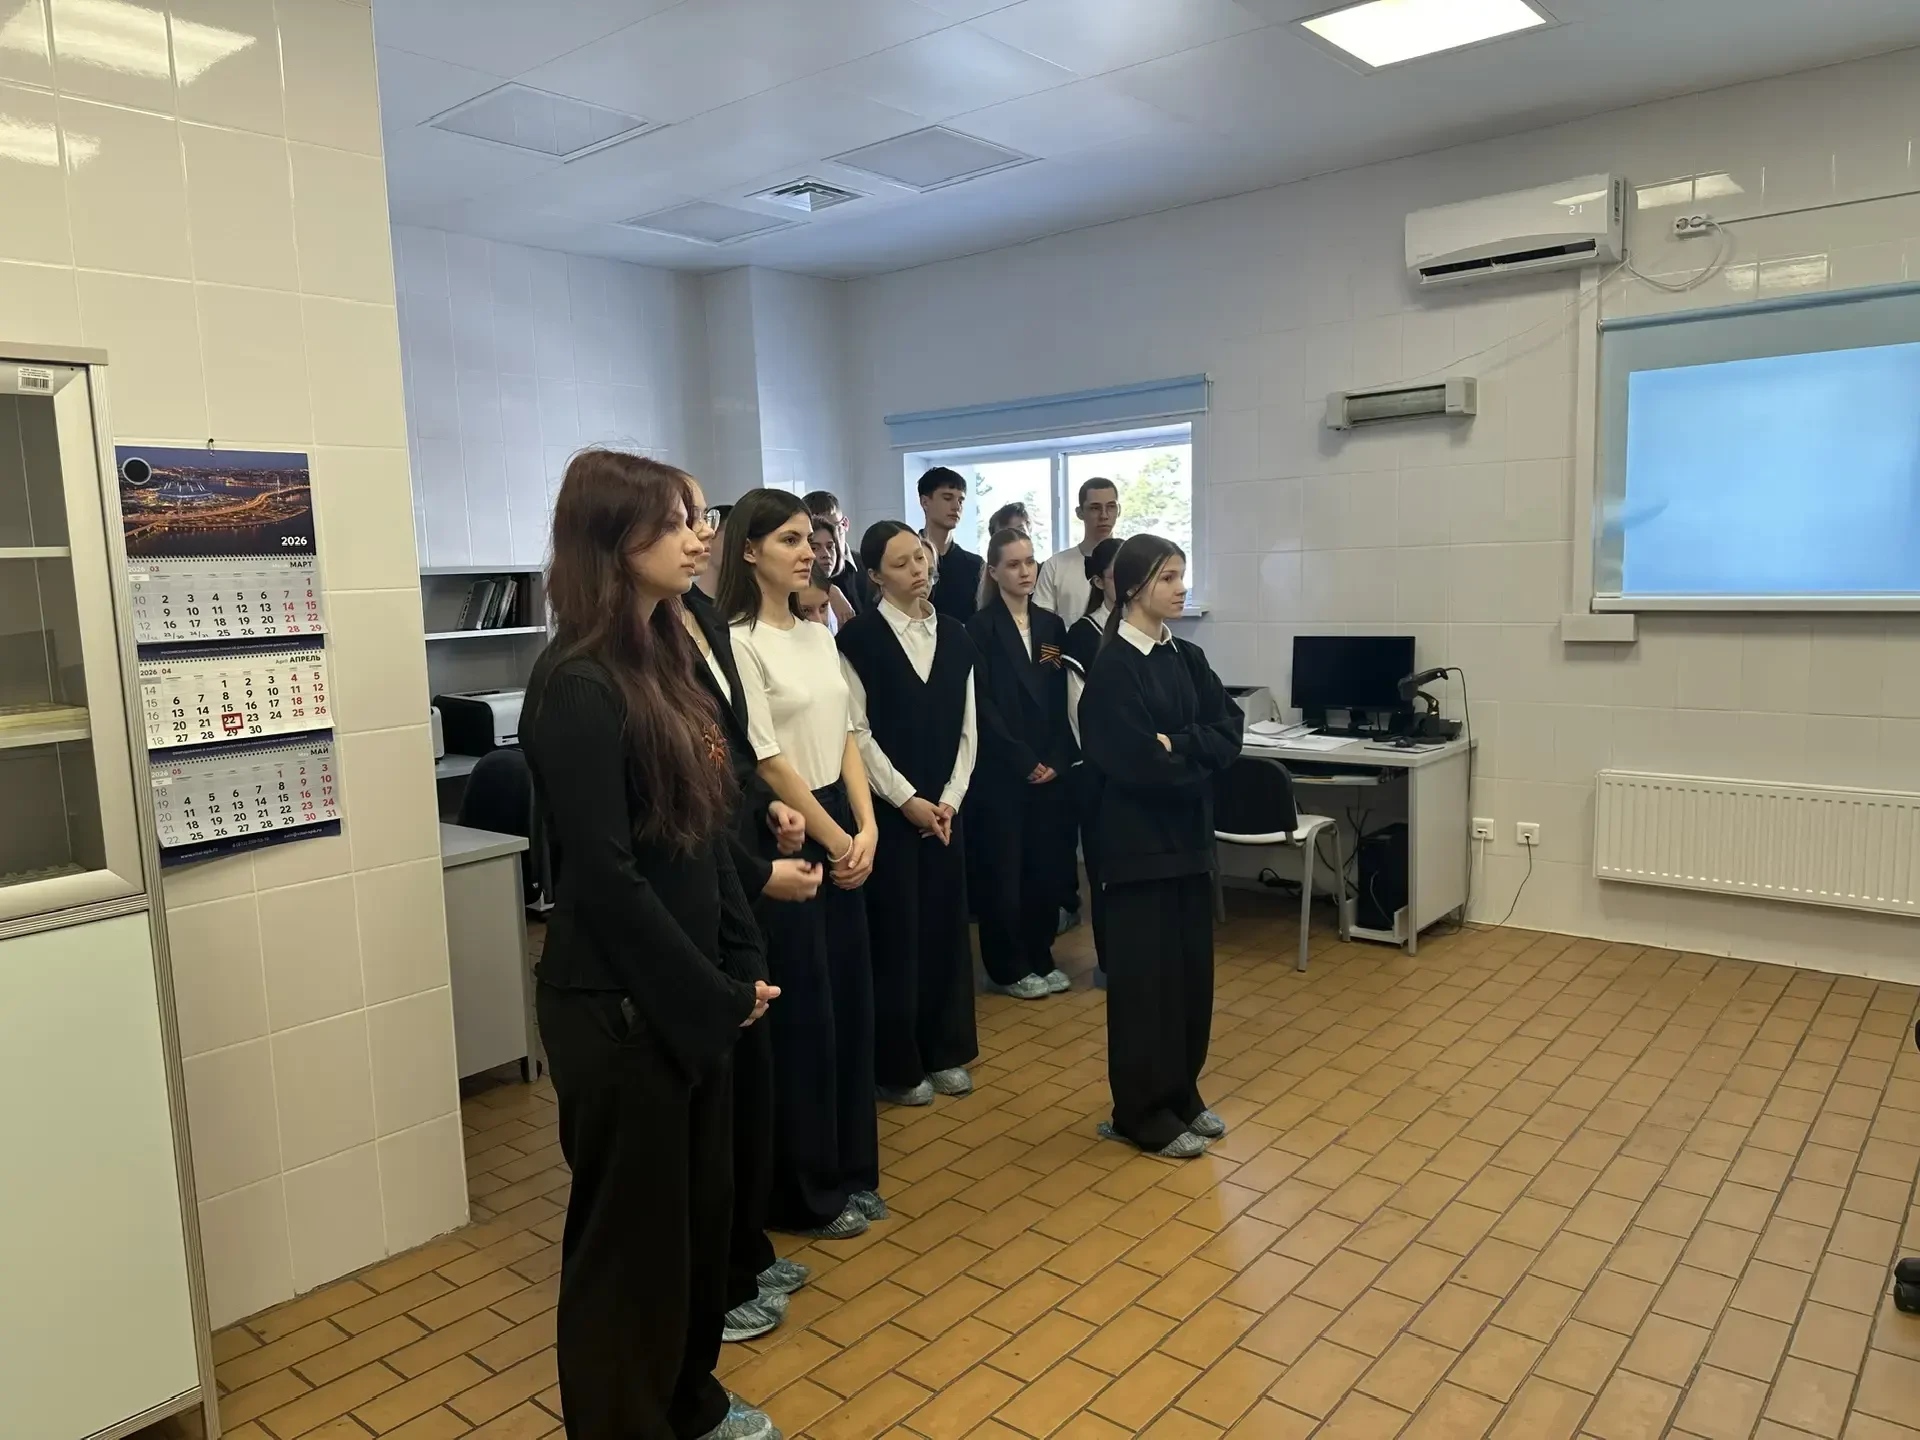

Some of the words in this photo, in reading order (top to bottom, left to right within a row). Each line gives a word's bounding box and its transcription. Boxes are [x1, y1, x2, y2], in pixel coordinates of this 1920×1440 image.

[1568, 204, 1583, 216] 21
[281, 536, 308, 546] 2026
[133, 596, 146, 605] 10
[162, 595, 169, 604] 2
[187, 594, 194, 603] 3
[212, 593, 219, 601] 4
[237, 592, 244, 600] 5
[260, 591, 267, 600] 6
[284, 590, 290, 598] 7
[306, 589, 313, 598] 8
[134, 583, 141, 592] 9
[136, 610, 147, 618] 11
[163, 608, 170, 617] 9
[186, 607, 199, 616] 10
[212, 606, 223, 614] 11
[236, 604, 248, 613] 12
[260, 603, 271, 612] 13
[282, 602, 294, 611] 14
[306, 601, 317, 610] 15
[138, 622, 151, 630] 12
[163, 621, 177, 629] 16
[189, 619, 200, 628] 17
[214, 618, 226, 626] 18
[238, 616, 250, 625] 19
[261, 616, 274, 624] 20
[284, 614, 296, 622] 21
[307, 613, 318, 621] 22
[290, 655, 321, 663] АПРЕЛЬ
[144, 686, 156, 695] 14
[222, 680, 227, 688] 1
[245, 678, 251, 686] 2
[268, 676, 275, 684] 3
[314, 672, 320, 680] 5
[146, 698, 158, 708] 15
[173, 696, 180, 705] 6
[198, 694, 204, 703] 7
[222, 692, 229, 700] 8
[246, 690, 253, 698] 9
[267, 687, 278, 696] 10
[290, 685, 300, 694] 11
[313, 683, 324, 691] 12
[147, 712, 159, 720] 16
[172, 708, 184, 718] 13
[196, 706, 209, 715] 14
[222, 704, 233, 712] 15
[245, 701, 257, 710] 16
[269, 699, 279, 708] 17
[291, 697, 302, 705] 18
[314, 694, 325, 703] 19
[148, 724, 160, 734] 17
[173, 721, 186, 731] 20
[198, 718, 210, 728] 21
[223, 716, 236, 725] 22
[246, 713, 259, 722] 23
[269, 711, 282, 719] 24
[292, 708, 304, 717] 25
[314, 706, 326, 714] 26
[152, 736, 164, 745] 18
[175, 734, 188, 742] 27
[200, 731, 214, 740] 28
[226, 728, 239, 737] 29
[249, 725, 262, 734] 30
[156, 787, 168, 797] 18
[300, 767, 306, 775] 2
[322, 764, 328, 772] 3
[157, 800, 169, 809] 19
[209, 793, 215, 802] 5
[233, 789, 239, 798] 6
[256, 785, 262, 794] 7
[278, 782, 285, 790] 8
[300, 778, 307, 786] 9
[321, 775, 332, 783] 10
[158, 812, 172, 822] 20
[184, 808, 195, 818] 11
[208, 805, 220, 814] 12
[232, 801, 244, 810] 13
[255, 797, 267, 806] 14
[278, 793, 289, 802] 15
[300, 790, 311, 798] 16
[322, 786, 332, 795] 17
[162, 825, 174, 834] 21
[186, 820, 199, 830] 18
[210, 816, 223, 825] 19
[234, 812, 246, 822] 20
[257, 809, 268, 818] 21
[280, 805, 292, 814] 22
[301, 801, 313, 810] 23
[322, 798, 335, 807] 24
[166, 836, 181, 846] 22
[190, 832, 204, 840] 25
[214, 828, 228, 836] 26
[238, 824, 249, 832] 27
[260, 820, 273, 829] 28
[282, 816, 294, 825] 29
[304, 812, 316, 821] 30
[326, 809, 336, 817] 31
